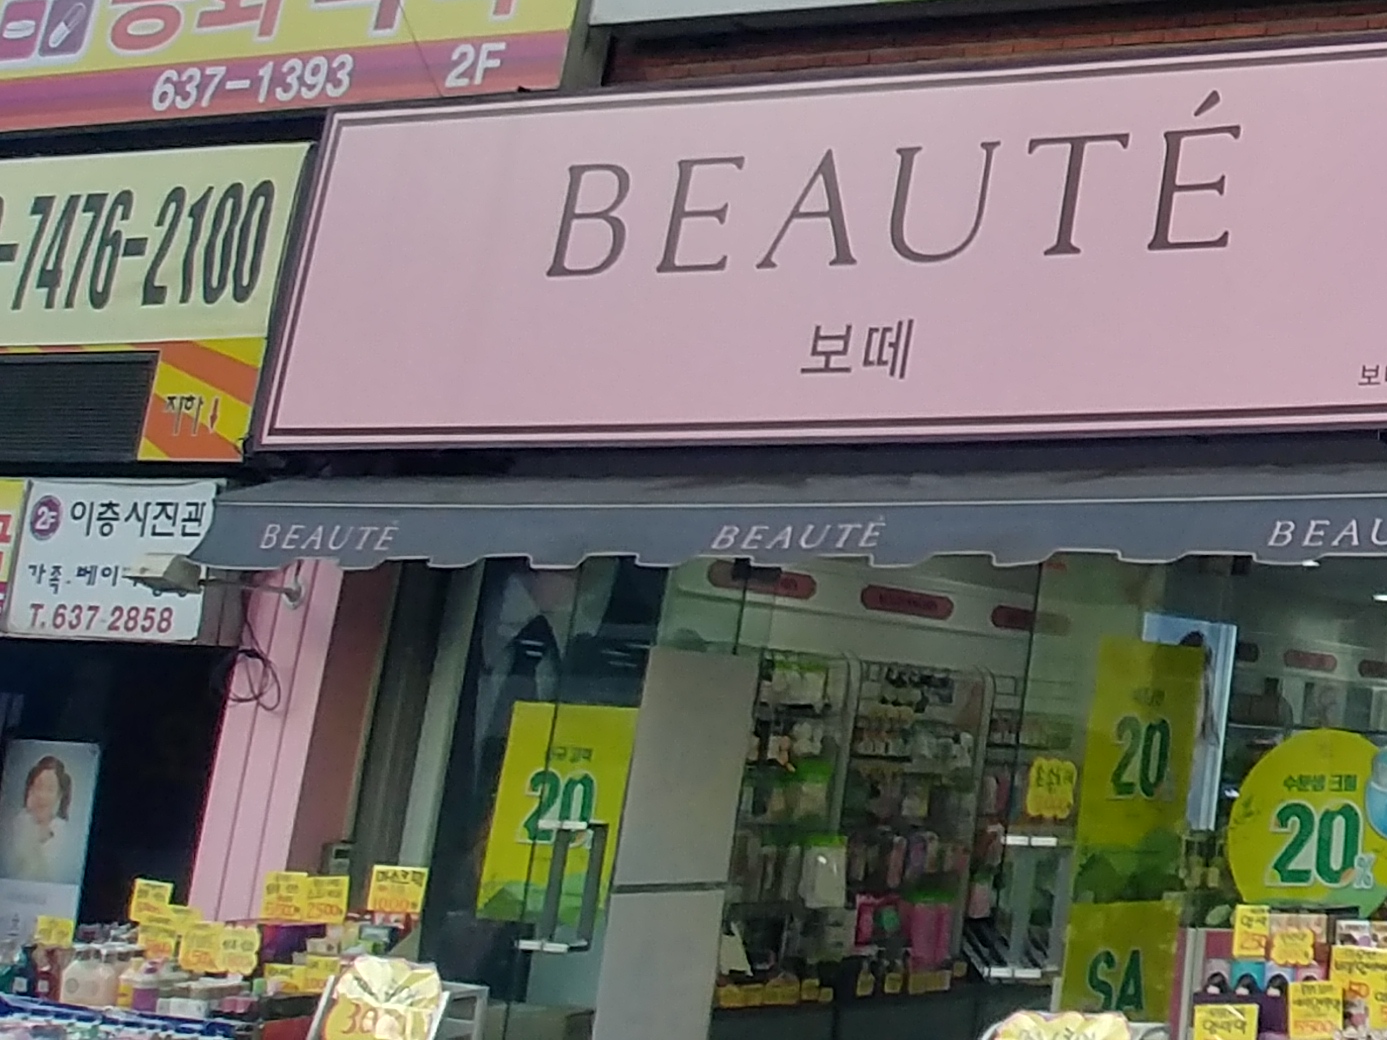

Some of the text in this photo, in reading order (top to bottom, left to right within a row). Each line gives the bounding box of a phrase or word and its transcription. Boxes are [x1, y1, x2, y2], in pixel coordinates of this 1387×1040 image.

[151, 41, 505, 112] 637-1393 2F
[544, 89, 1243, 279] BEAUTÉ
[800, 317, 916, 382] 보떼
[165, 395, 204, 436] 지하
